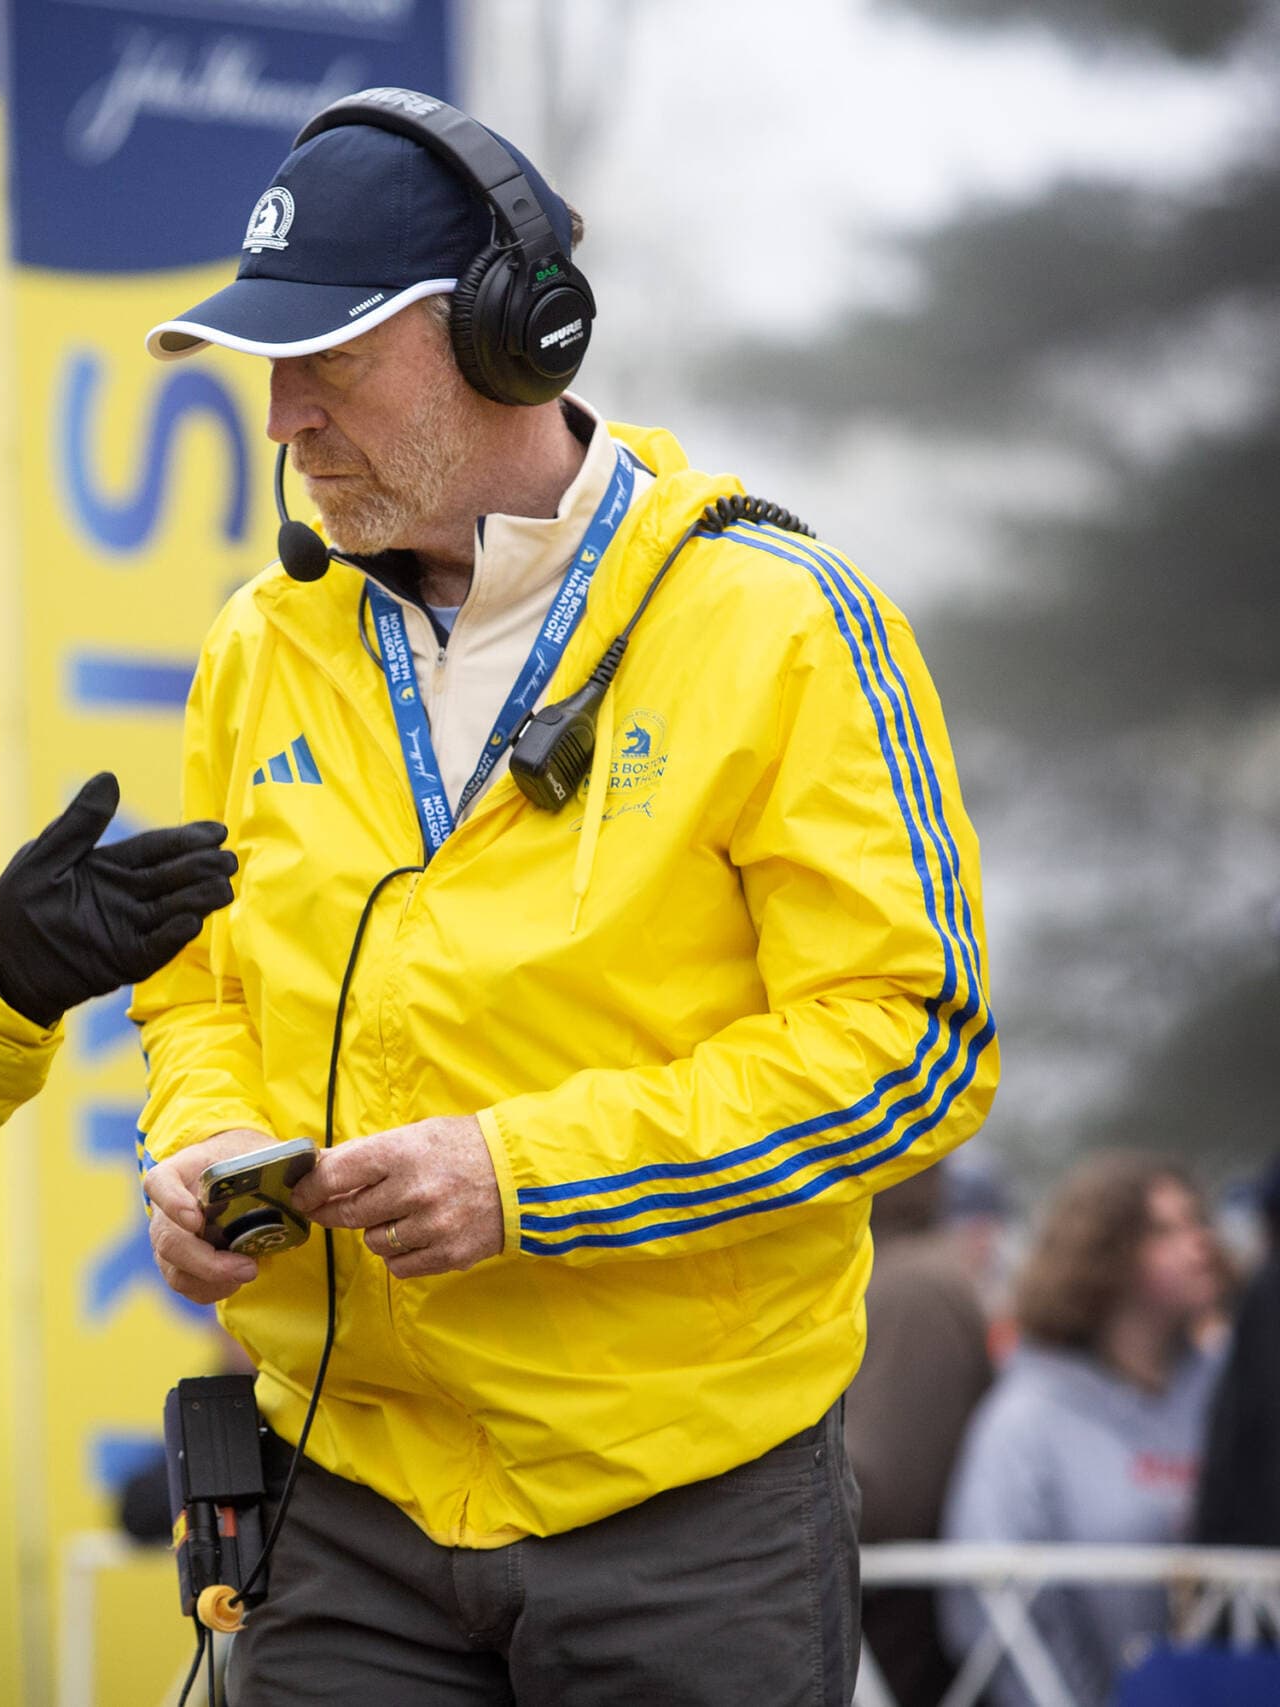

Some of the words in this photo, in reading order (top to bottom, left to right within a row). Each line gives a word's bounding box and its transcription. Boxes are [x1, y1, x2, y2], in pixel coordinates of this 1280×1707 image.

[540, 318, 582, 349] SHURE
[543, 567, 583, 642] MARATHON
[575, 574, 592, 597] THE
[378, 614, 397, 661] BOSTON
[553, 596, 582, 645] BOSTON
[389, 612, 412, 681] MARATHON
[389, 661, 401, 684] THE
